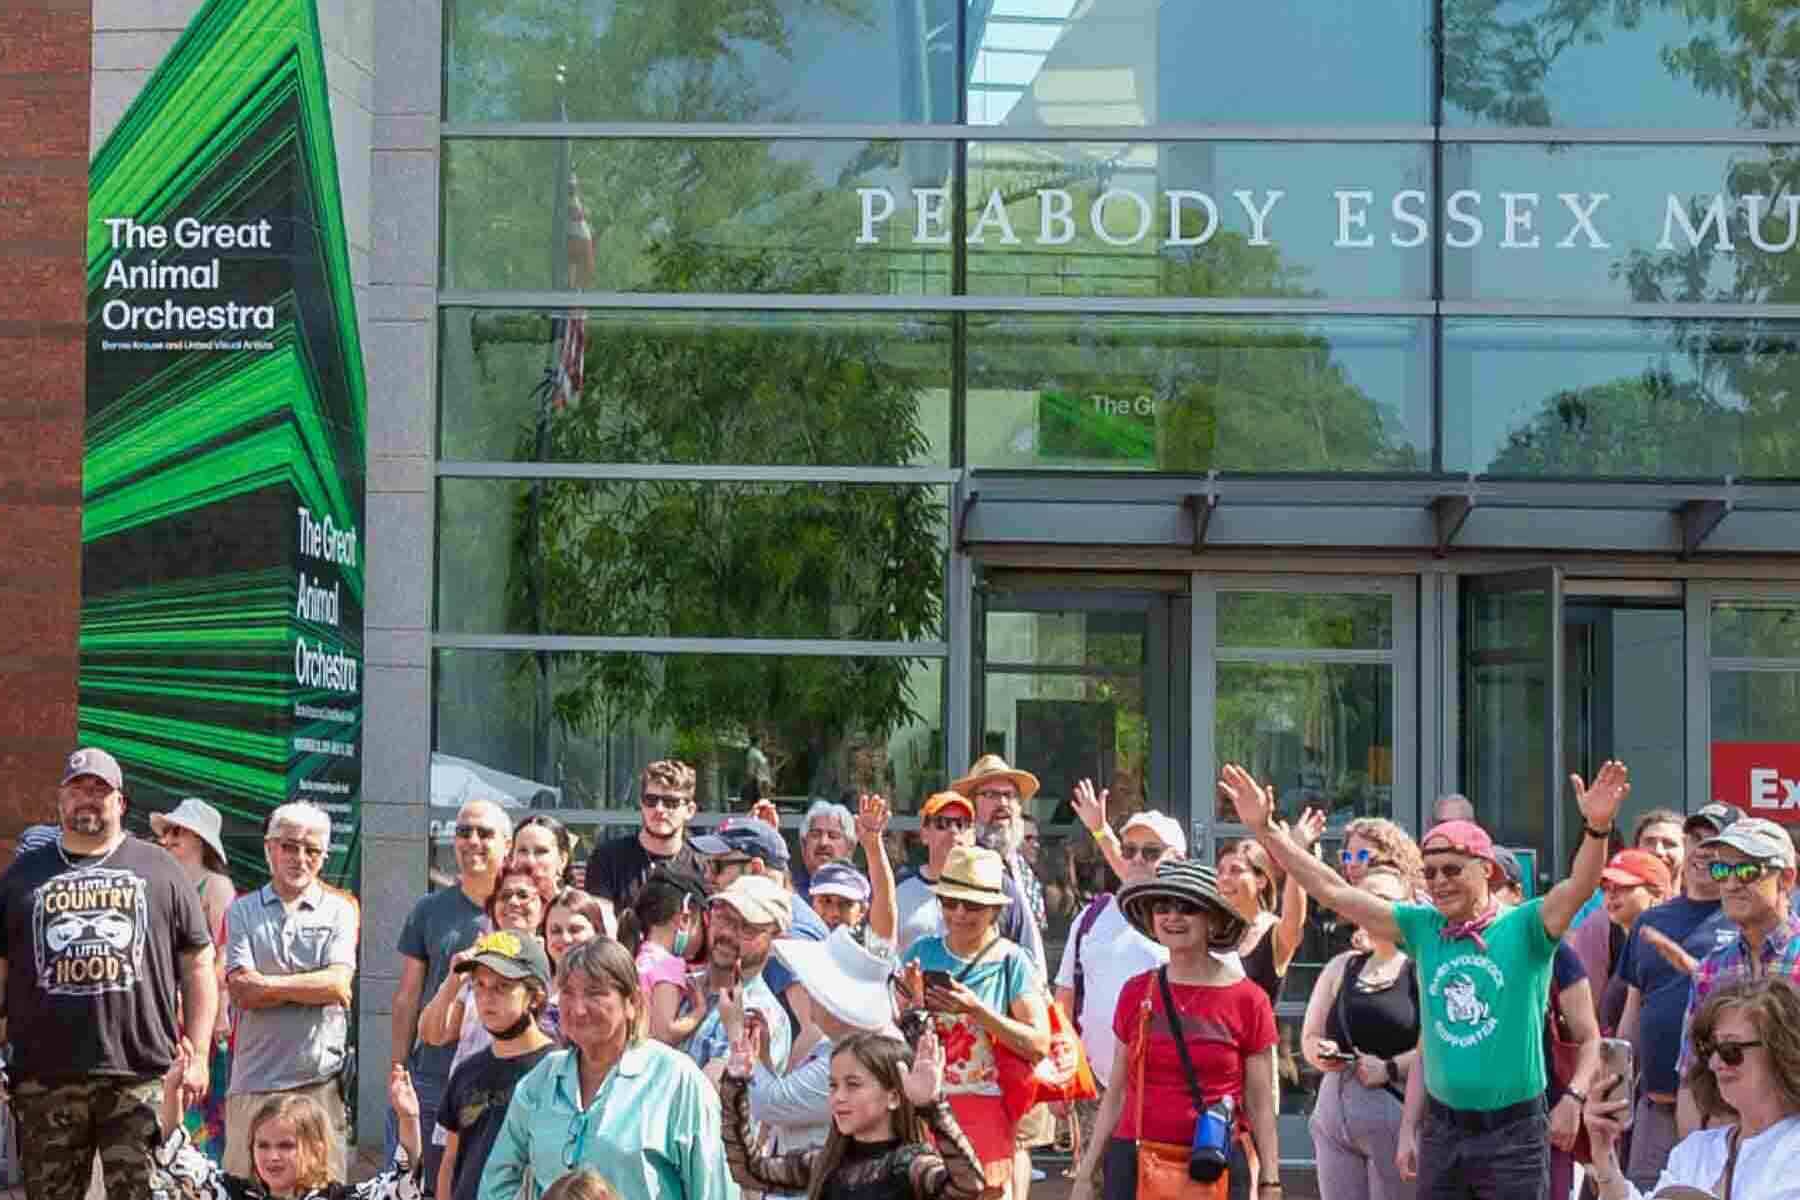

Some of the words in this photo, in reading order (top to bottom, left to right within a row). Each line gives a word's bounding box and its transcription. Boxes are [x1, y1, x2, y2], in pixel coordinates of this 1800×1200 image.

[103, 217, 168, 249] The
[174, 217, 273, 249] Great
[855, 187, 1287, 248] PEABODY
[1333, 190, 1612, 250] ESSEX
[1657, 193, 1800, 254] MU
[103, 257, 219, 290] Animal
[102, 299, 275, 331] Orchestra
[1088, 393, 1129, 417] The
[297, 506, 321, 559] The
[323, 513, 357, 567] Great
[296, 572, 339, 626] Animal
[295, 635, 358, 692] Orchestra
[46, 888, 136, 913] COUNTRY
[75, 944, 110, 956] LITTLE
[56, 956, 119, 984] HOOD
